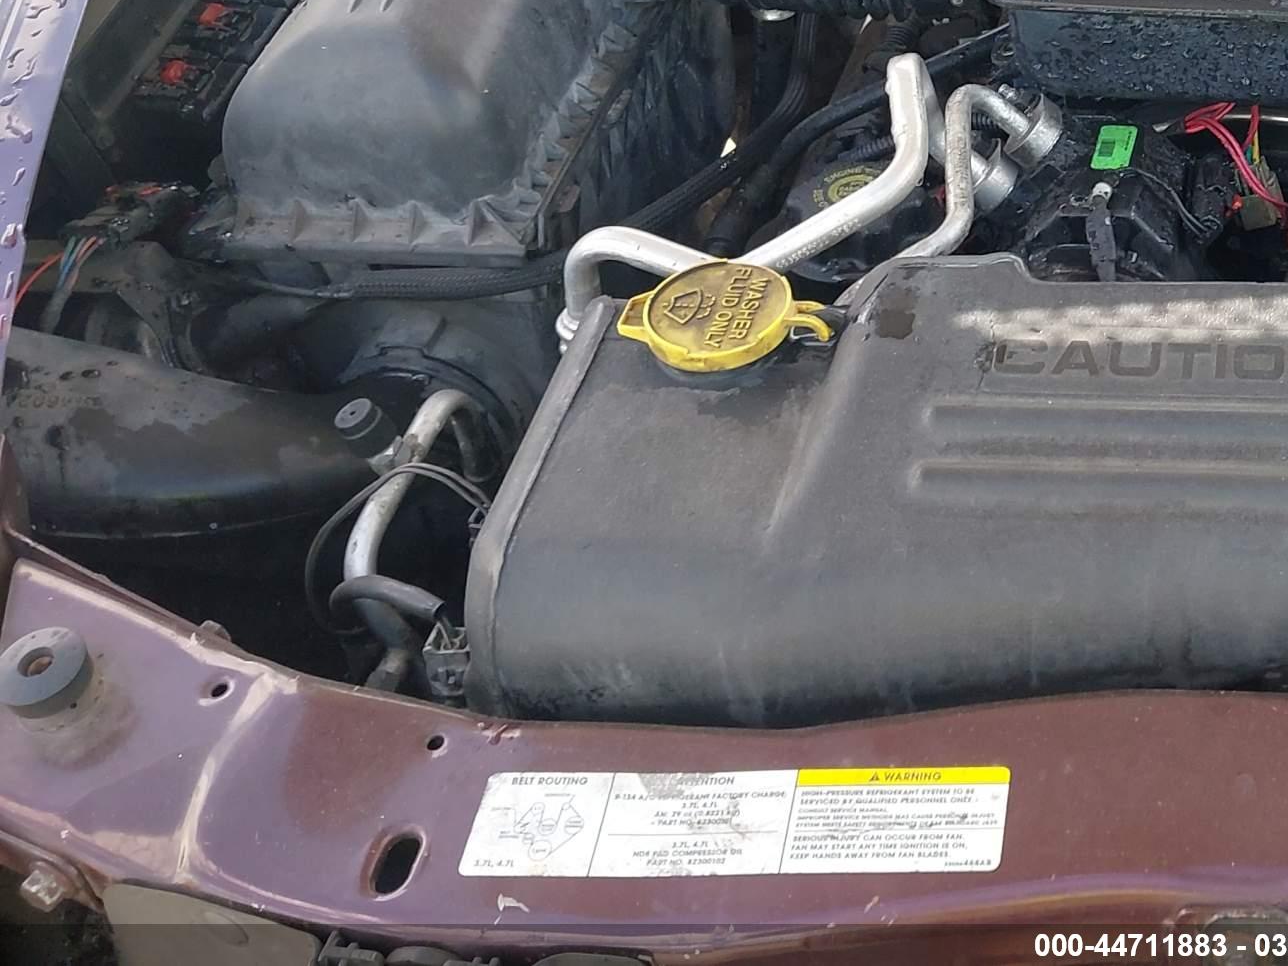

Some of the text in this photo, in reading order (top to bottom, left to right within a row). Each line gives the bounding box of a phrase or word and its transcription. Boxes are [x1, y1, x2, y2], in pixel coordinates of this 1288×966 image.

[704, 267, 752, 348] FLUID ONLY
[728, 277, 772, 340] WASHER
[511, 776, 588, 786] BELT ROUTING
[883, 771, 943, 782] WARNING
[952, 787, 964, 795] TO
[800, 797, 840, 806] SERVICED
[855, 796, 898, 804] QUALIFIED
[900, 796, 947, 804] PERSONNEL
[863, 833, 882, 841] CAN
[884, 833, 917, 841] OCCUR
[791, 843, 808, 851] FAN
[831, 842, 857, 850] START
[859, 842, 876, 850] ANY
[879, 842, 898, 850] TIME
[789, 852, 810, 860] KEEP
[811, 852, 842, 860] HANDS
[844, 851, 869, 859] AWAY
[871, 851, 896, 859] FROM
